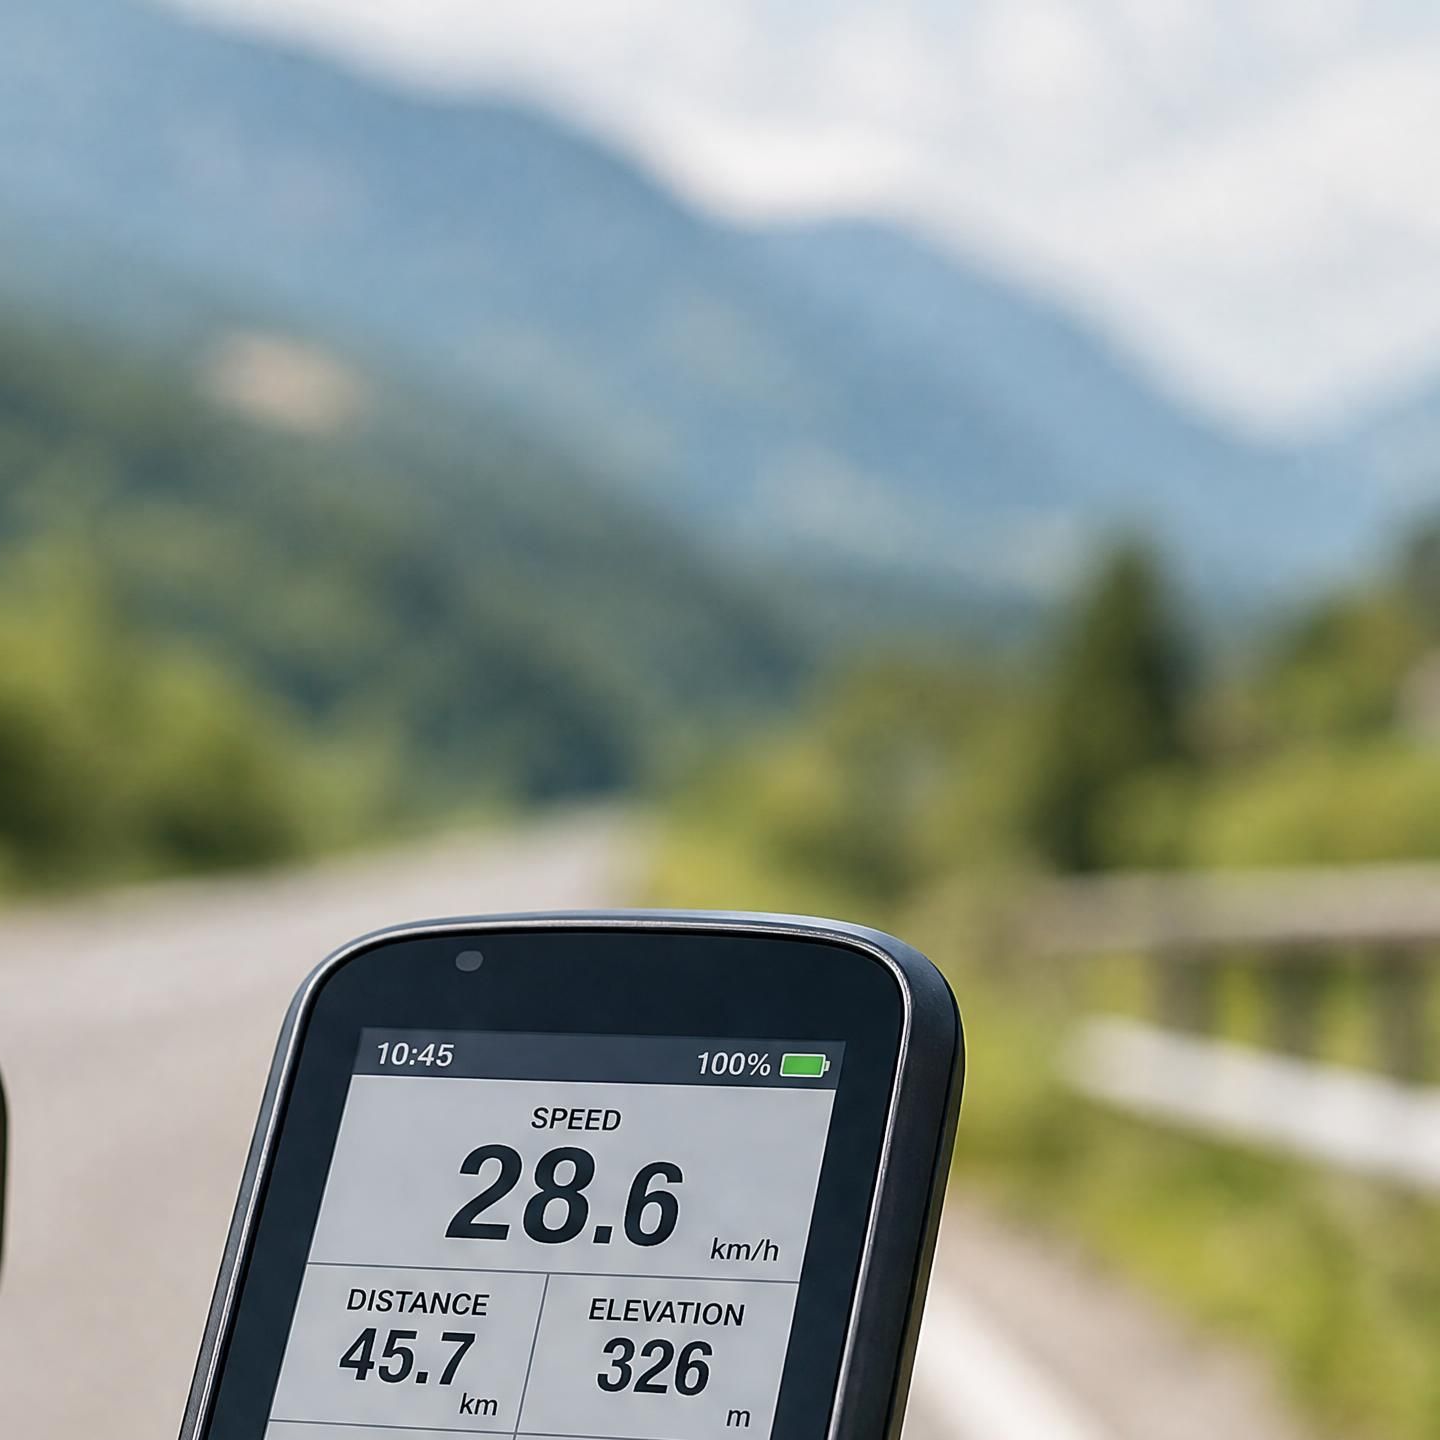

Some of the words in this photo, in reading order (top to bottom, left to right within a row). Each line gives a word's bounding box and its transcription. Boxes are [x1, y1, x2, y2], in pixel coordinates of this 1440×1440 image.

[377, 1042, 453, 1067] 10:45
[697, 1051, 771, 1076] 100%
[530, 1107, 622, 1131] SPEED
[445, 1144, 683, 1247] 28.6
[710, 1237, 779, 1261] km/h
[346, 1288, 490, 1316] DISTANCE
[588, 1298, 745, 1326] ELEVATION
[339, 1327, 475, 1386] 45.7
[459, 1393, 498, 1416] km
[596, 1337, 713, 1396] 326
[726, 1407, 752, 1427] m
